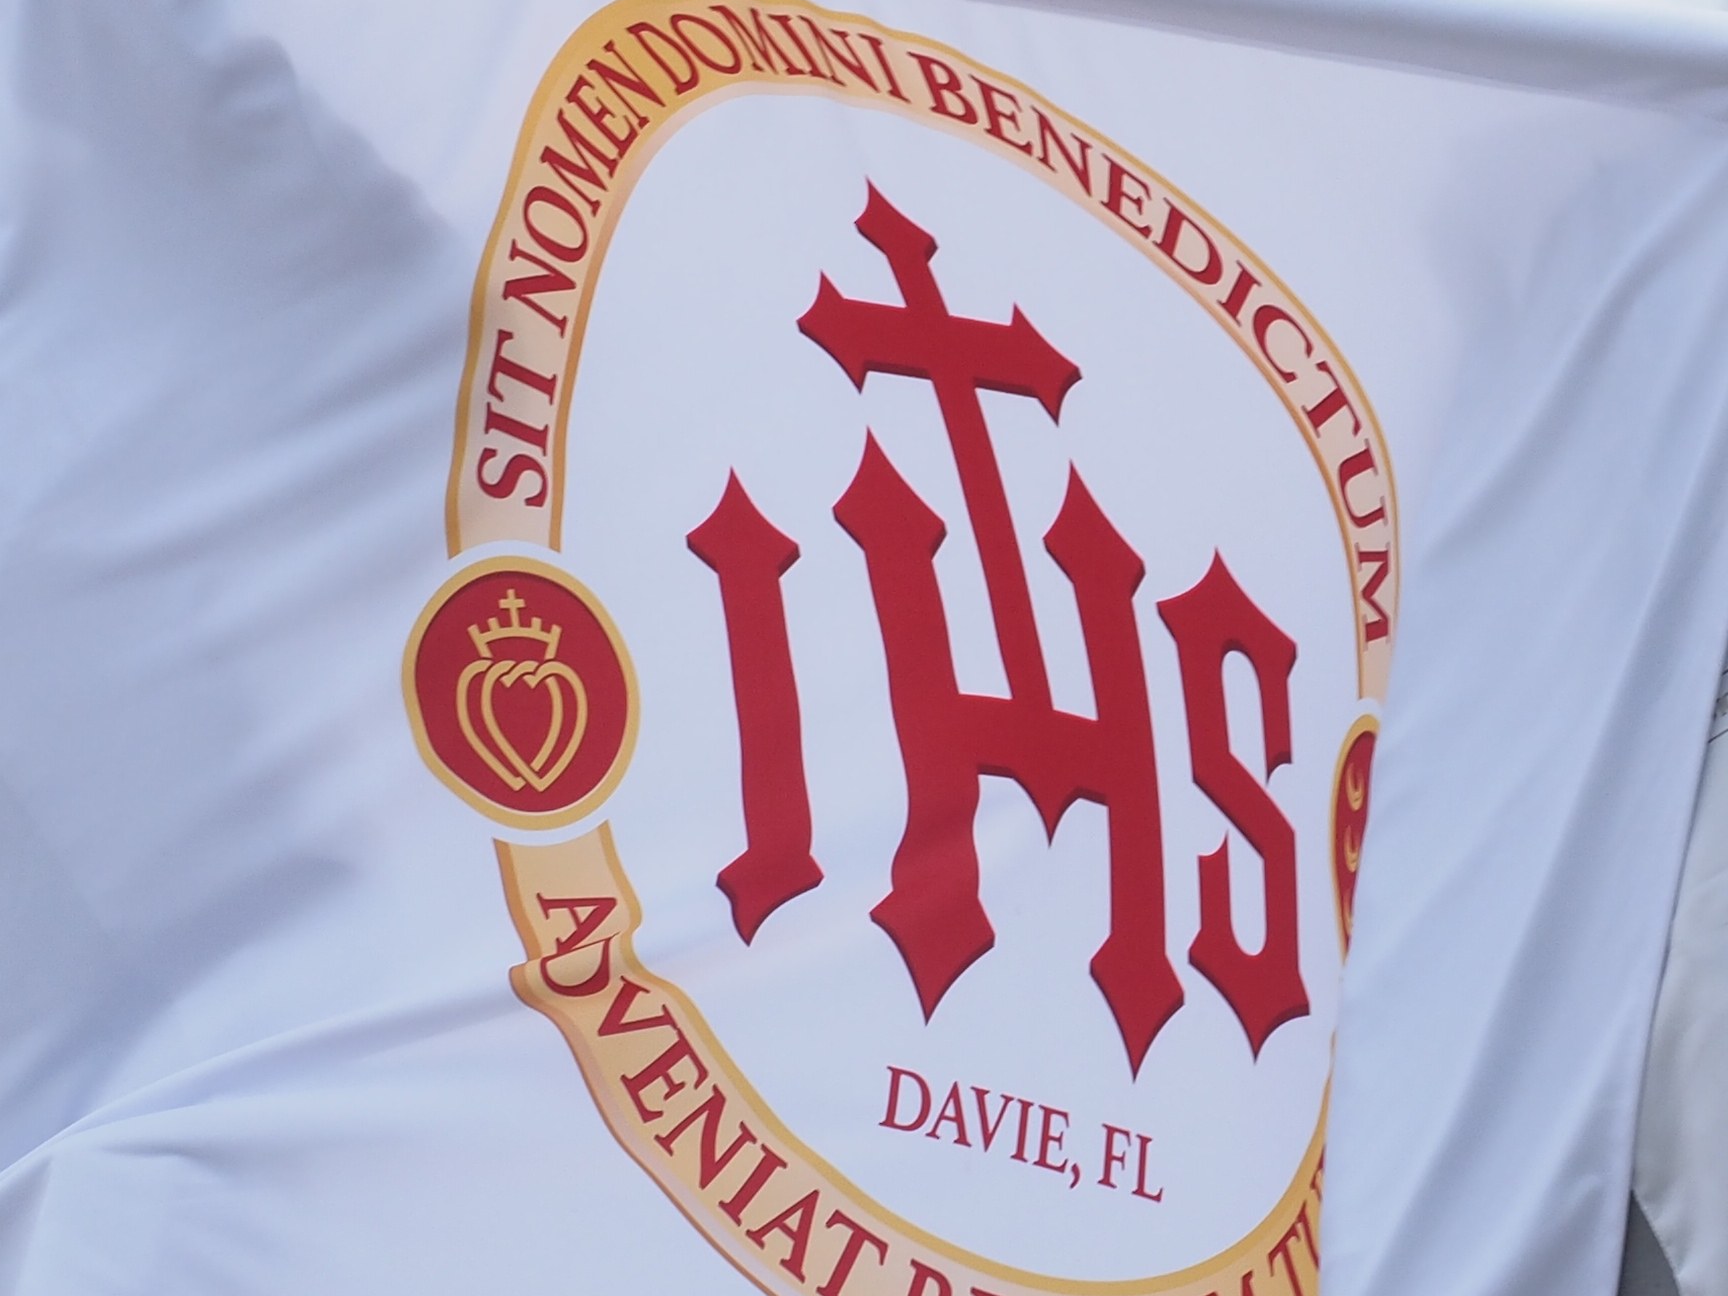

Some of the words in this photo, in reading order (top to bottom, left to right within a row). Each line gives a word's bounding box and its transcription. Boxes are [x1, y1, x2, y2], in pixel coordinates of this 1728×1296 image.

[625, 4, 912, 104] DOMINI
[502, 39, 667, 339] NOMEN
[476, 329, 560, 508] SIT
[907, 50, 1392, 652] BENEDICTUM
[686, 176, 1311, 1083] IHS
[878, 1065, 1081, 1190] DAVIE,
[1097, 1122, 1164, 1203] FL
